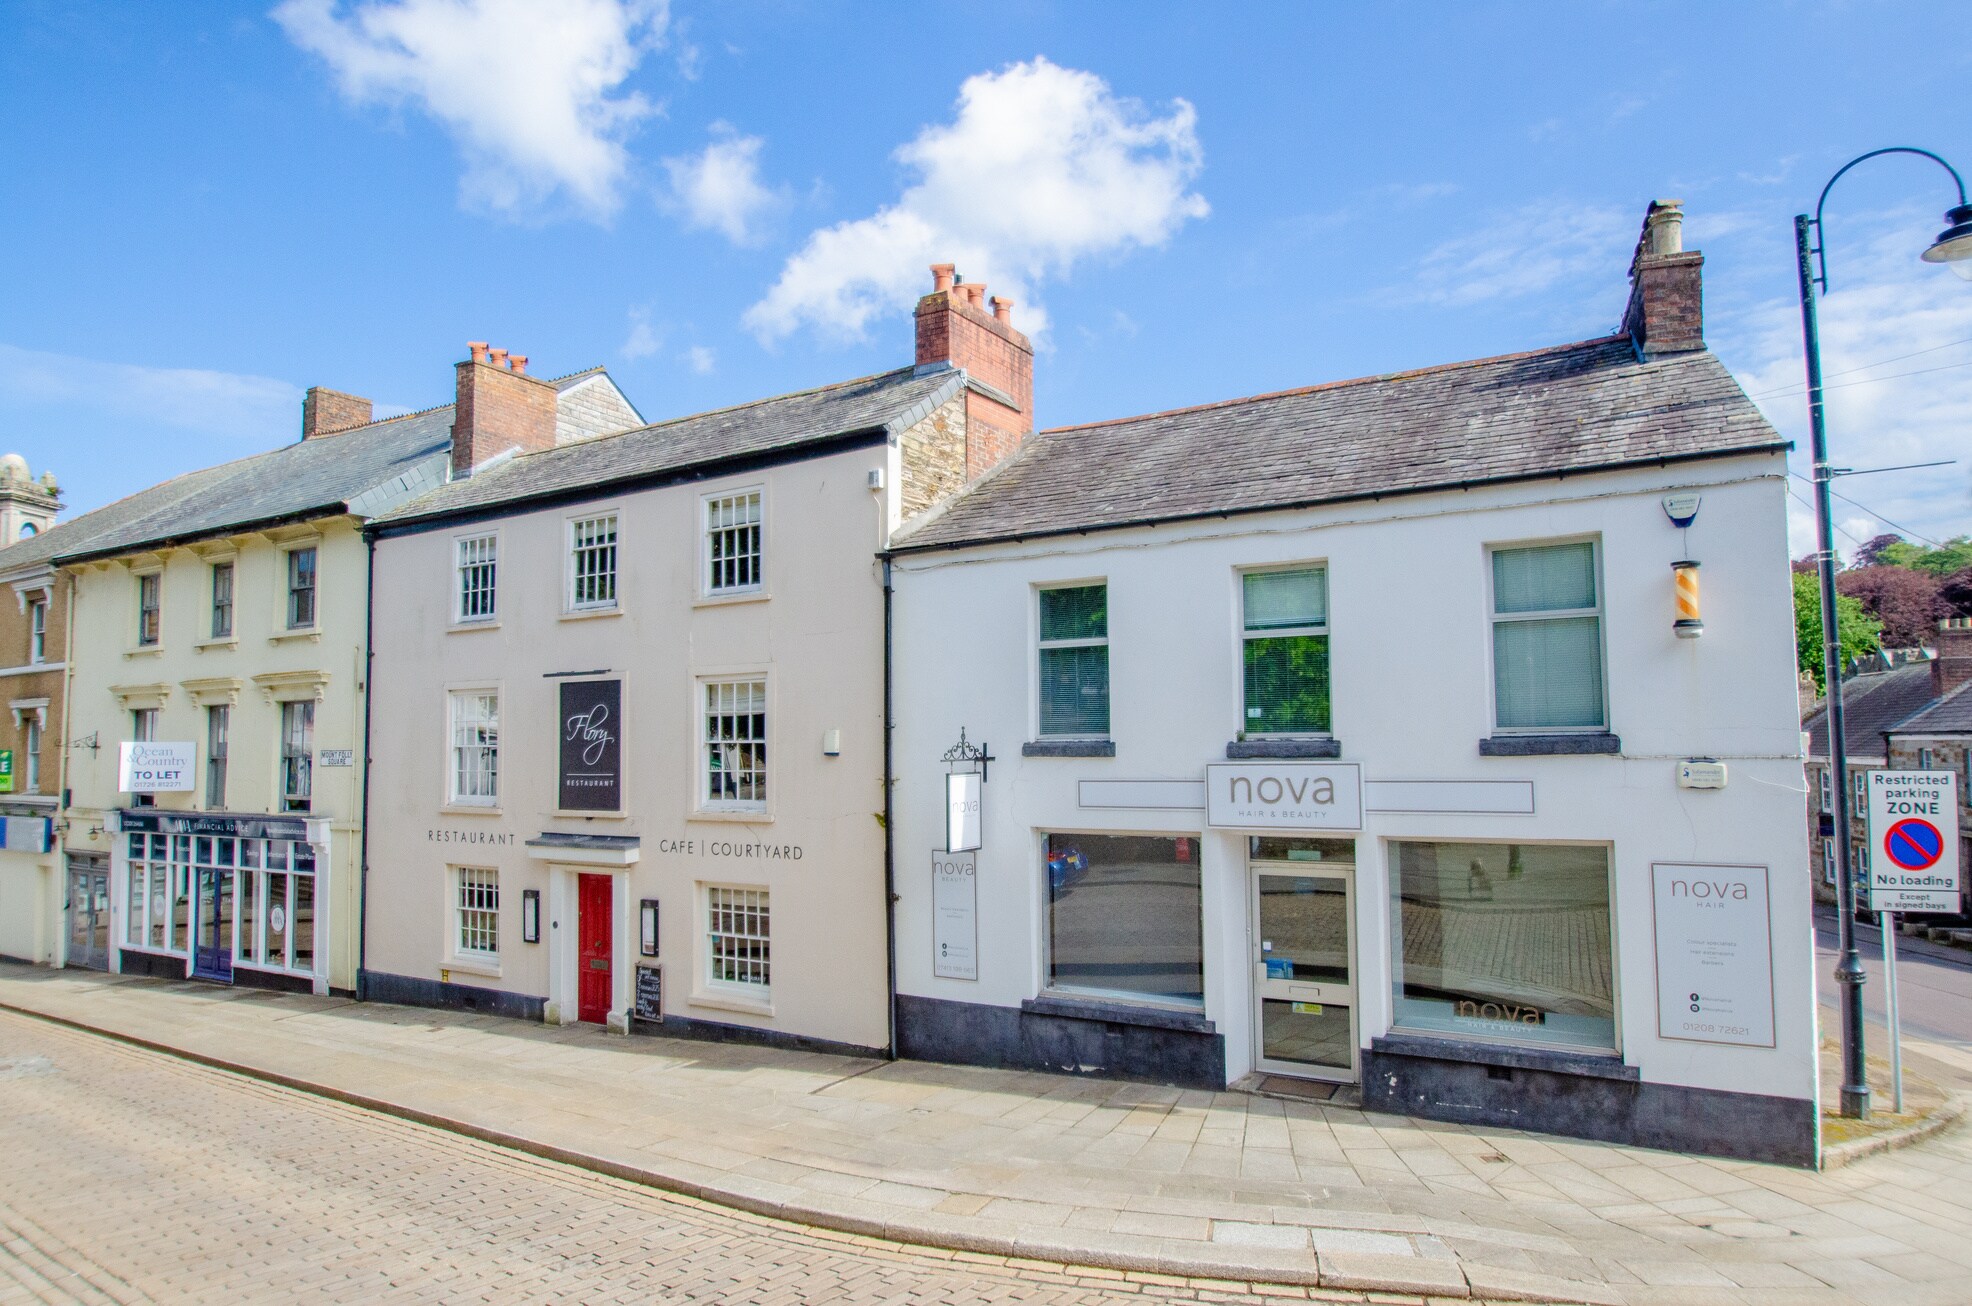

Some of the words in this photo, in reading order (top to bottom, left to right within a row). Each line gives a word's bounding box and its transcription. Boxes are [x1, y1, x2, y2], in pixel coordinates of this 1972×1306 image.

[566, 703, 615, 766] Flory
[133, 745, 173, 757] Ocean
[339, 751, 352, 759] FOLLY
[137, 755, 187, 769] Country
[134, 770, 153, 780] TO
[156, 770, 181, 779] LET
[1875, 774, 1949, 785] Restricted
[1229, 776, 1335, 805] nova
[1886, 788, 1939, 800] parking
[952, 799, 979, 813] nova
[1887, 802, 1940, 814] ZONE
[1282, 810, 1328, 819] BEAUTY
[194, 823, 224, 831] FINANCIAL
[226, 824, 249, 833] ADVICE
[428, 830, 515, 846] RESTAURANT
[659, 839, 694, 854] CAFE
[710, 842, 803, 860] COURTYARD
[934, 861, 974, 876] nova
[1877, 875, 1896, 885] No
[1900, 875, 1953, 888] loading
[1671, 880, 1748, 900] nova
[1900, 893, 1930, 901] Except
[1696, 901, 1725, 909] HAIR
[1895, 901, 1923, 909] signed
[1925, 902, 1946, 910] bays
[1460, 1000, 1541, 1026] nova
[1682, 1022, 1715, 1033] 01208
[1718, 1025, 1750, 1036] 72621
